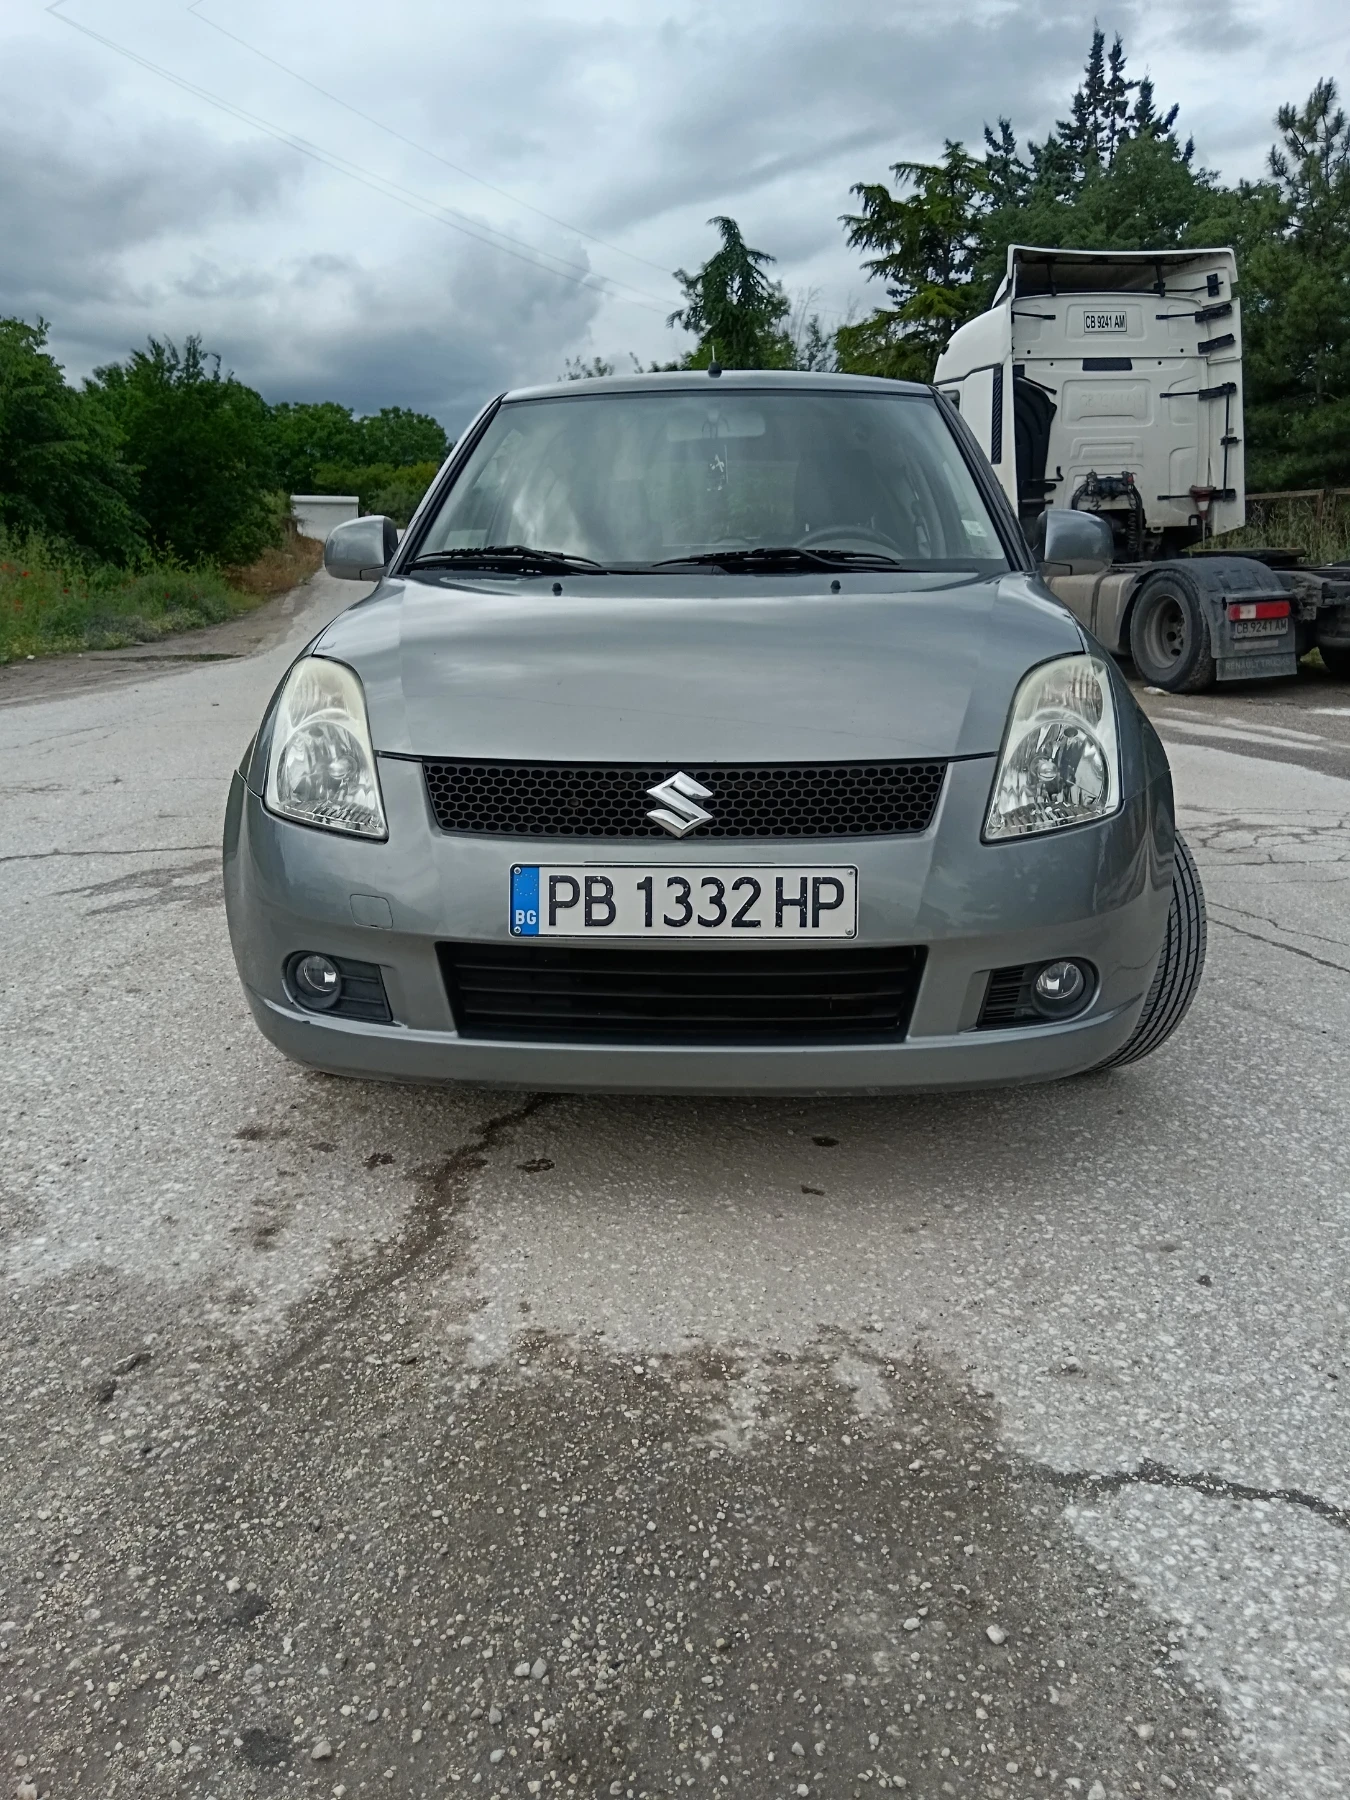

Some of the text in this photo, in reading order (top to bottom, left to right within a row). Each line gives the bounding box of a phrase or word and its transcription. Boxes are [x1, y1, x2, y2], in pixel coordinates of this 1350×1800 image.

[1085, 315, 1126, 329] CB 9241 AM
[1236, 619, 1287, 634] CB 9241 AM
[1225, 657, 1291, 670] RENAULT TRUCKS
[548, 875, 845, 928] PB 1332 HP
[515, 909, 537, 925] BG
